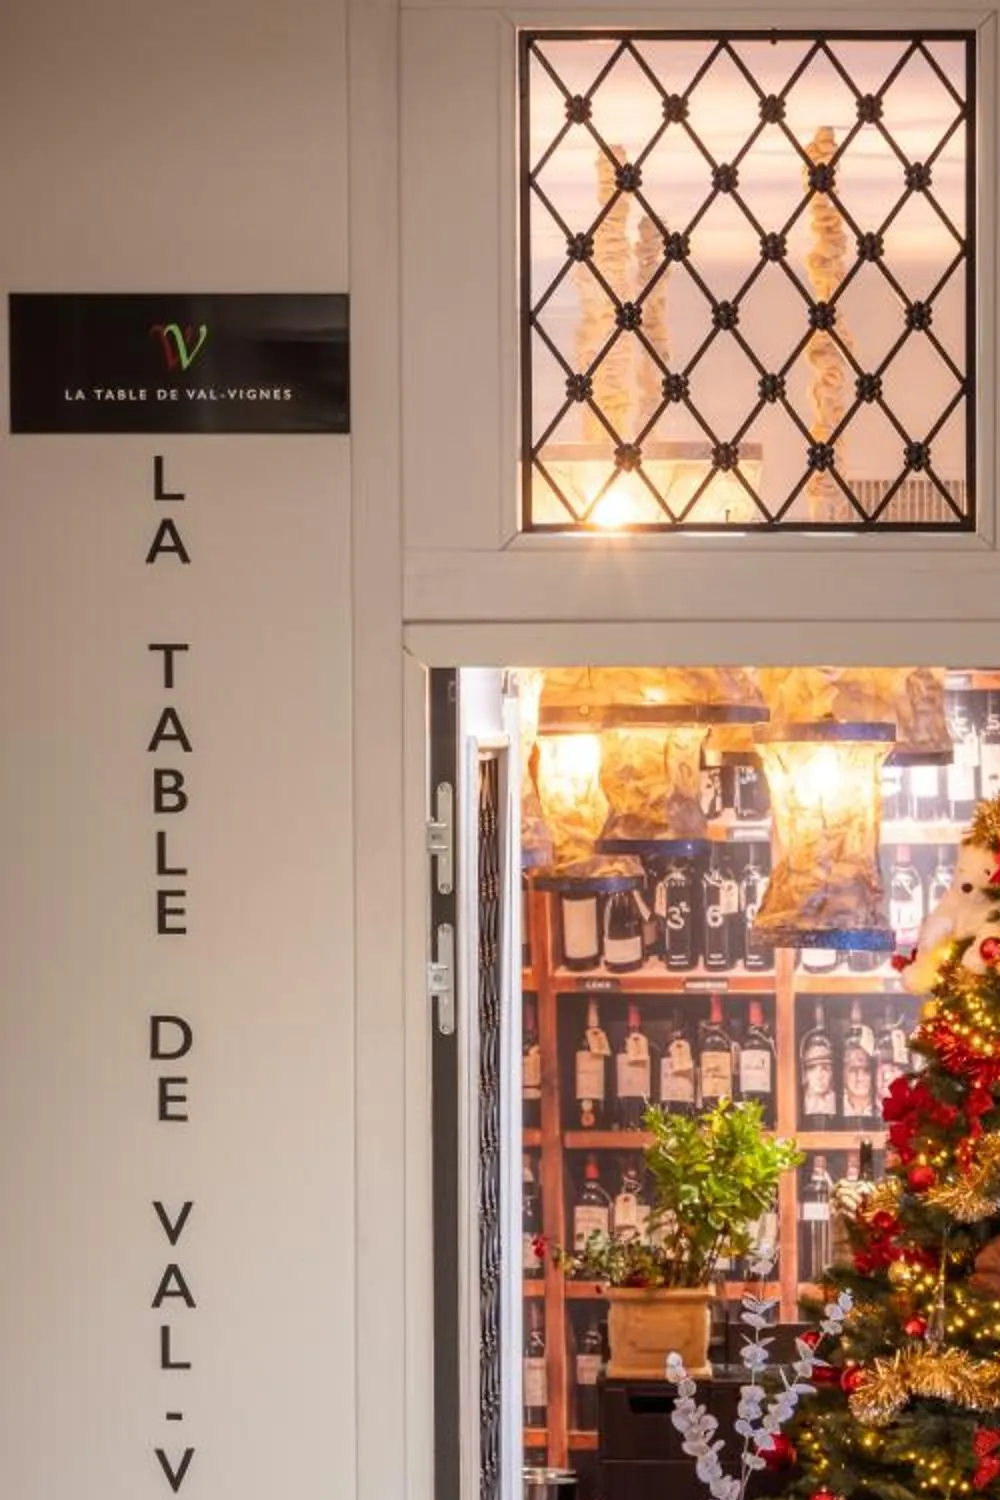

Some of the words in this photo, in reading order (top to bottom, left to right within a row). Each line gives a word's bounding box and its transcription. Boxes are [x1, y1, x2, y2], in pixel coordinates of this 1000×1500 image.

[64, 389, 86, 401] LA
[94, 389, 147, 401] TABLE
[156, 389, 178, 401] DE
[186, 388, 292, 401] VAL-VIGNES
[145, 455, 192, 564] LA
[147, 643, 193, 935] TABLE
[150, 1015, 193, 1121] DE
